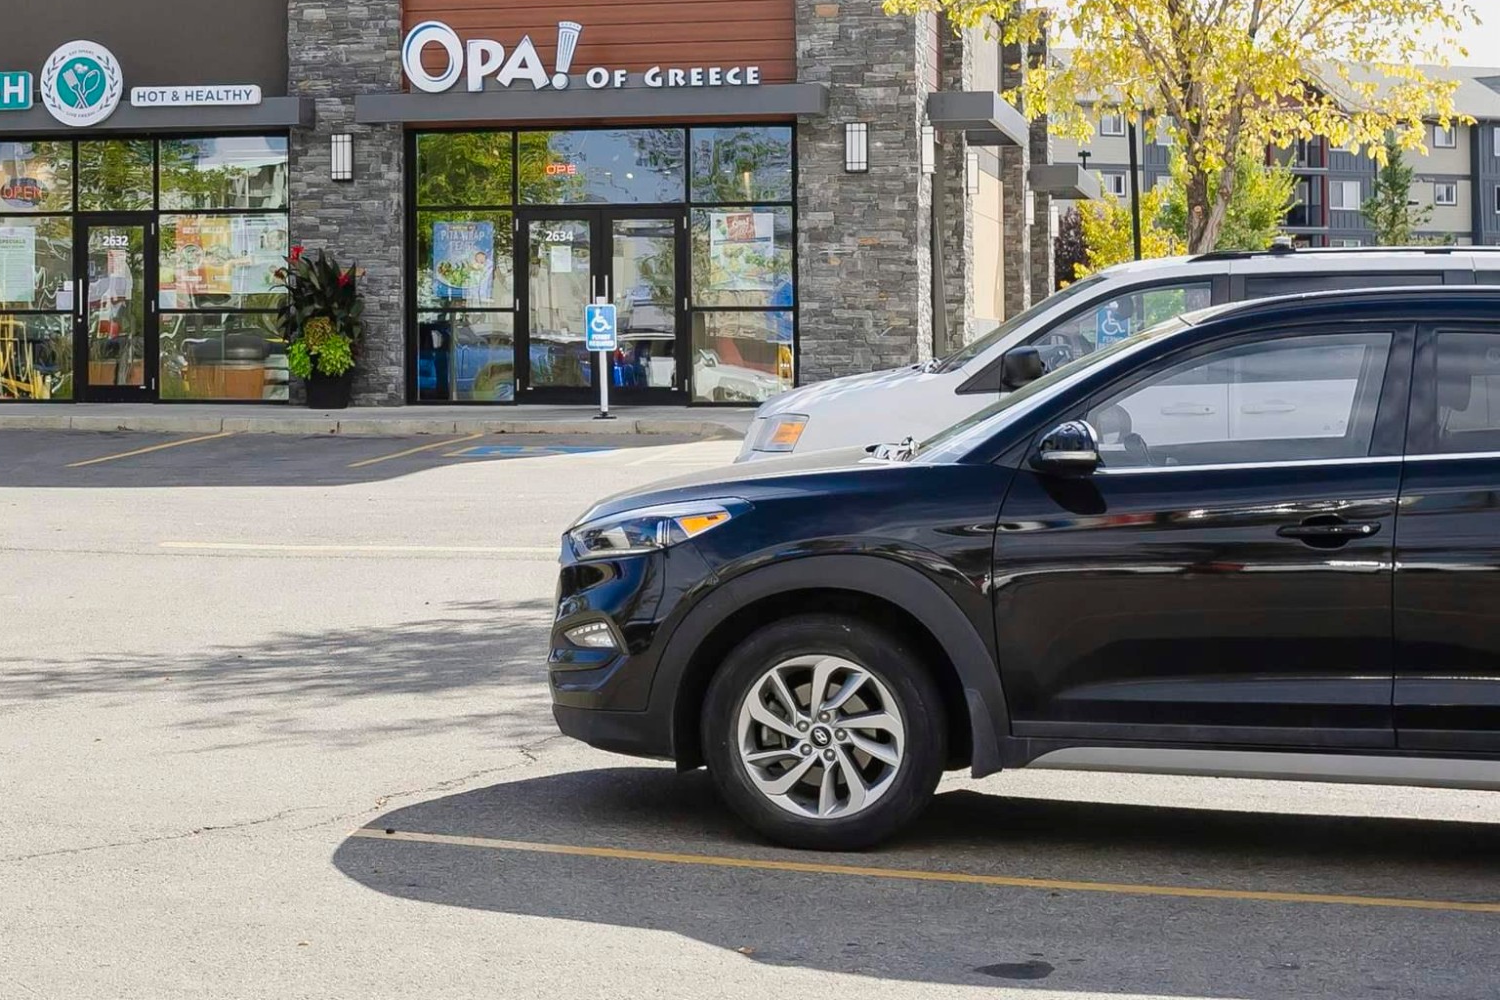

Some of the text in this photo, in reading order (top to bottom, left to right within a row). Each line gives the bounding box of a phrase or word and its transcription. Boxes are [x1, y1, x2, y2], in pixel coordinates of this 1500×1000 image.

[402, 20, 760, 93] OPA! OF GREECE
[137, 89, 253, 102] HOT & HEALTHY
[3, 185, 42, 199] OPEN
[102, 235, 129, 246] 2632
[545, 230, 574, 241] 2634
